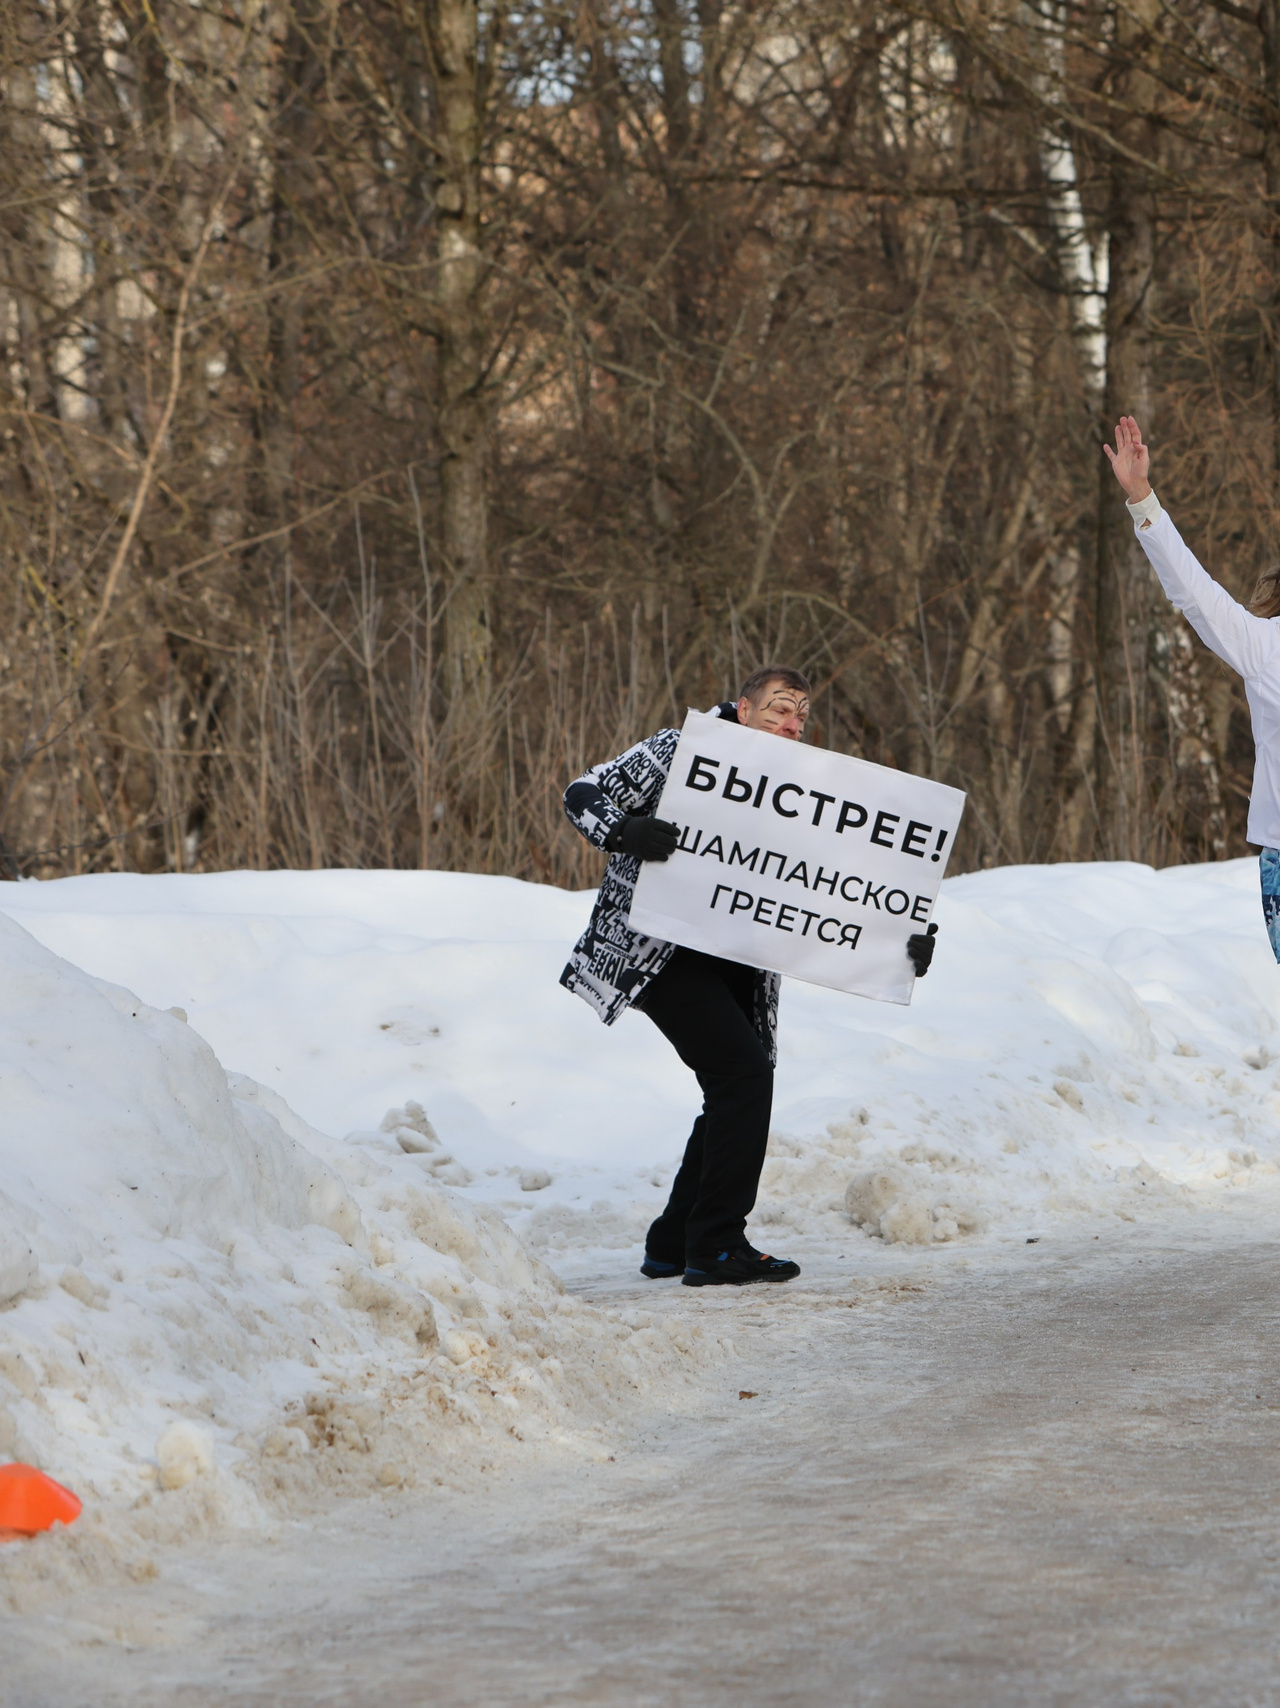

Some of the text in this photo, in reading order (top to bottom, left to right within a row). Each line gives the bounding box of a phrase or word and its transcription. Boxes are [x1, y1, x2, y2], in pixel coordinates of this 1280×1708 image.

[685, 754, 949, 863] БЫСТРЕЕ!
[671, 821, 933, 924] ШАМПАНСКОЕ
[605, 926, 630, 950] RIDE
[709, 884, 863, 950] ГРЕЕТСЯ
